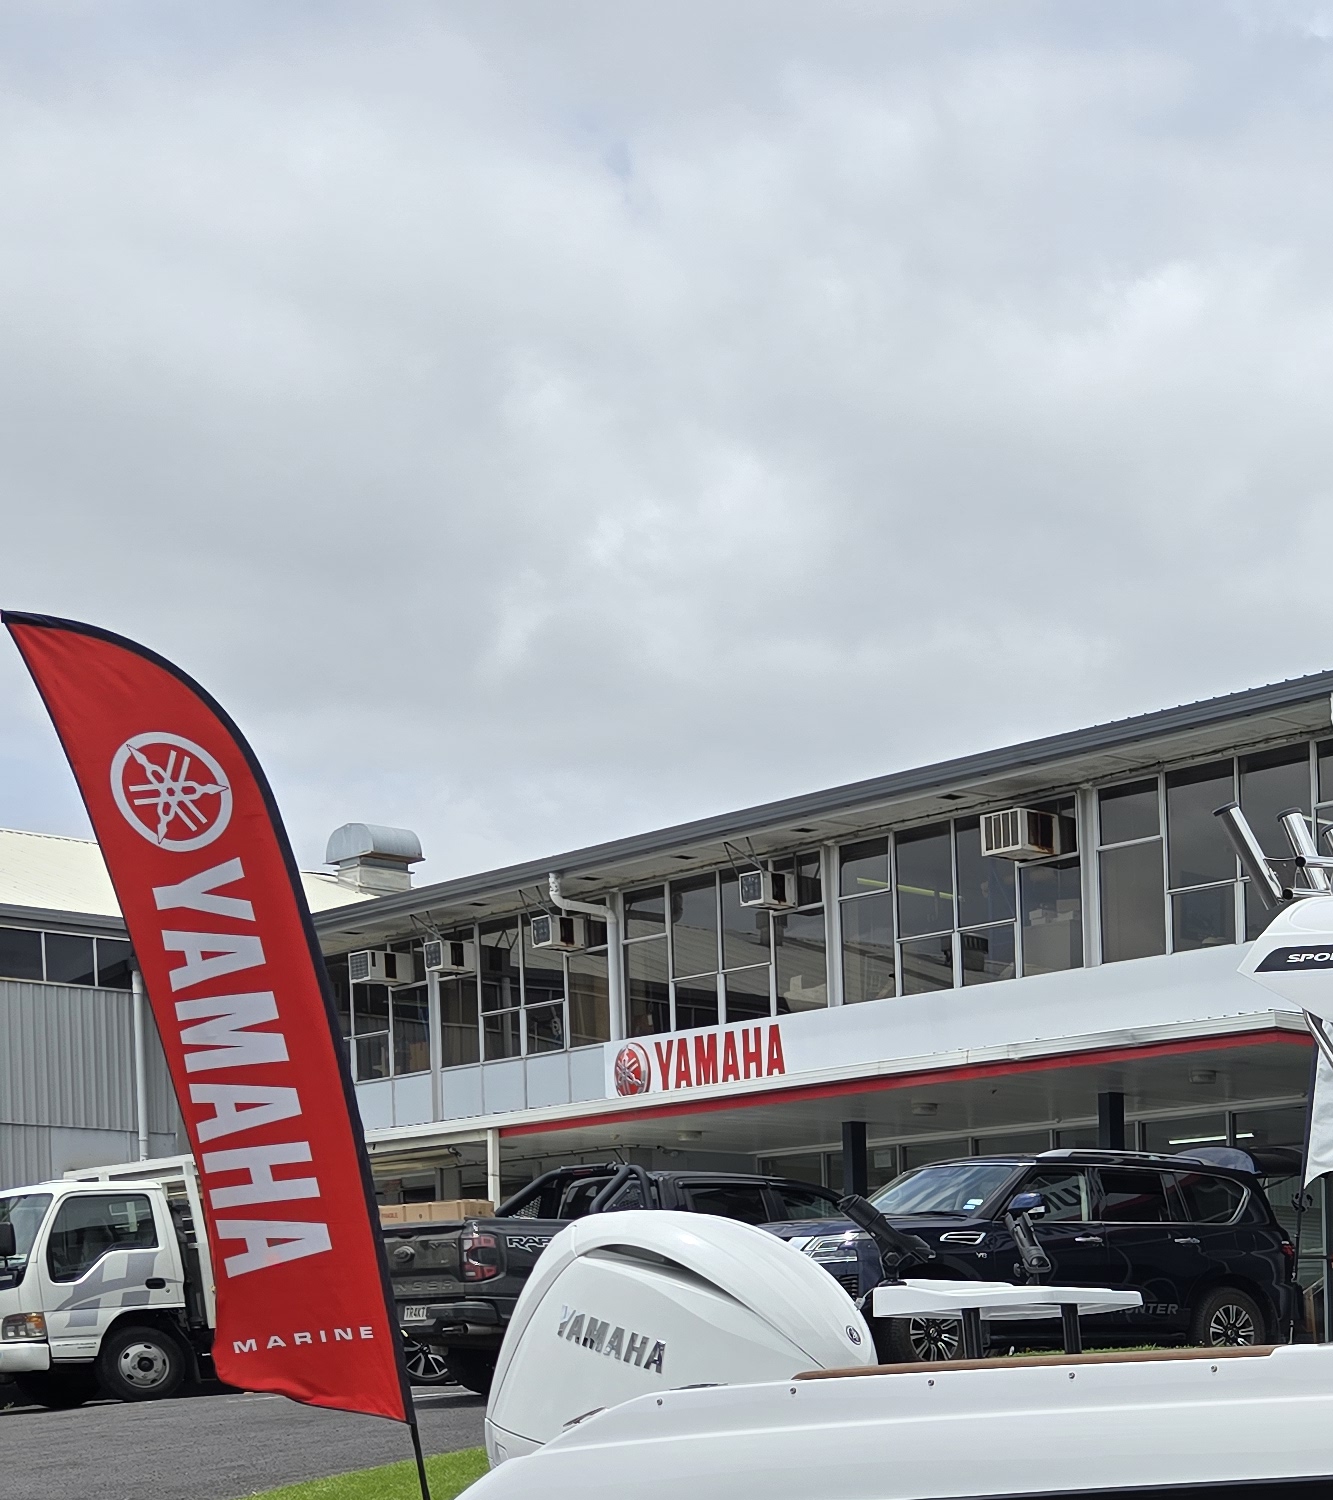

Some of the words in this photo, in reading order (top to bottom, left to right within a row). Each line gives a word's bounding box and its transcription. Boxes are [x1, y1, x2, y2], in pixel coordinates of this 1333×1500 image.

[152, 856, 333, 1279] YAMAHA
[654, 1024, 786, 1091] YAMAHA
[233, 1325, 375, 1354] MARINE
[557, 1305, 667, 1374] YAMAHA
